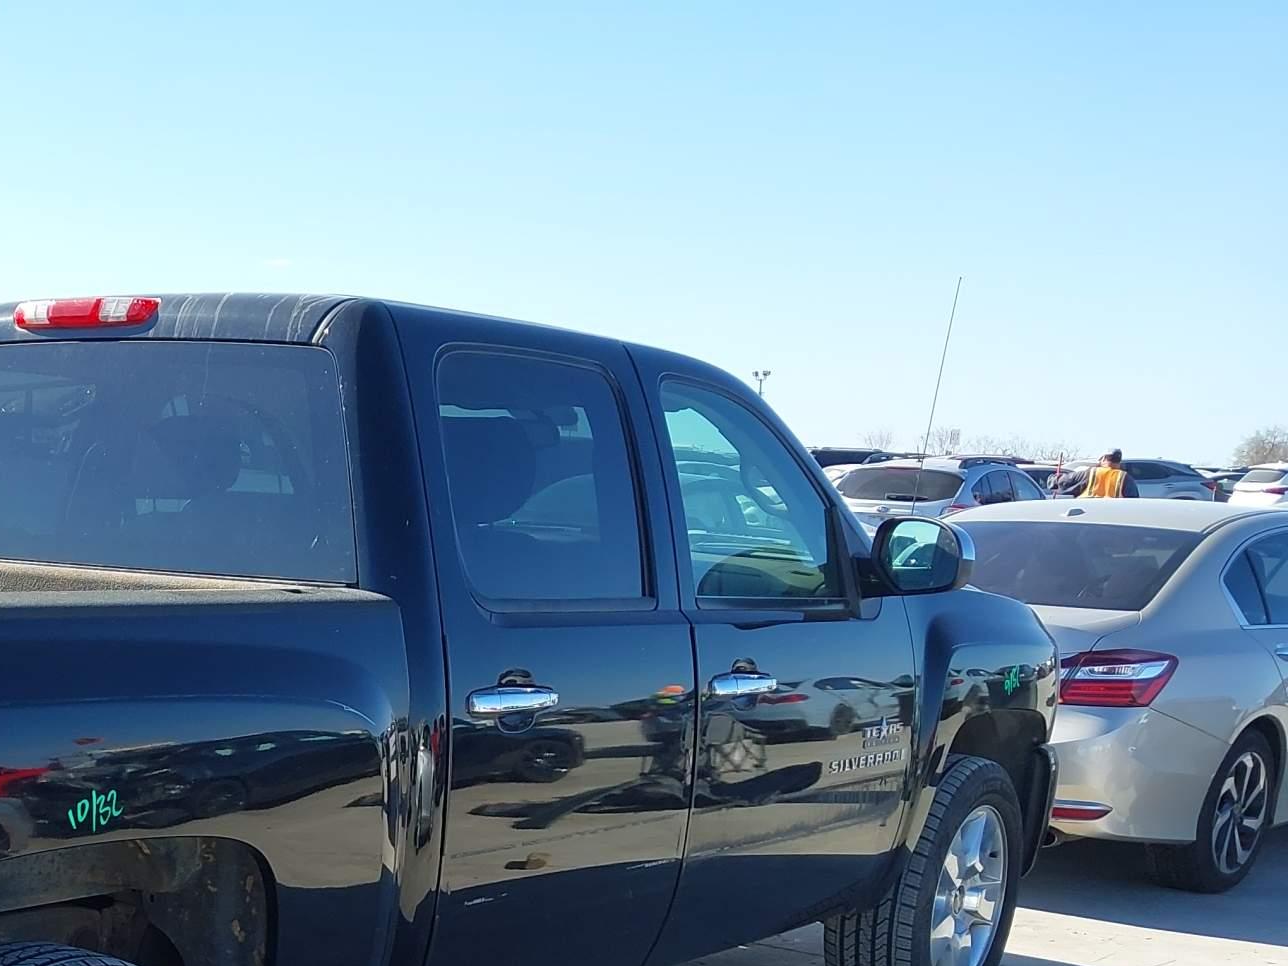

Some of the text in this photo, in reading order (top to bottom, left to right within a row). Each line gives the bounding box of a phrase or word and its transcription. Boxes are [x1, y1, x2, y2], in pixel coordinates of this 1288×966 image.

[862, 717, 904, 740] TEXAS
[830, 750, 901, 774] SILVERADO
[67, 789, 124, 833] 10/32
